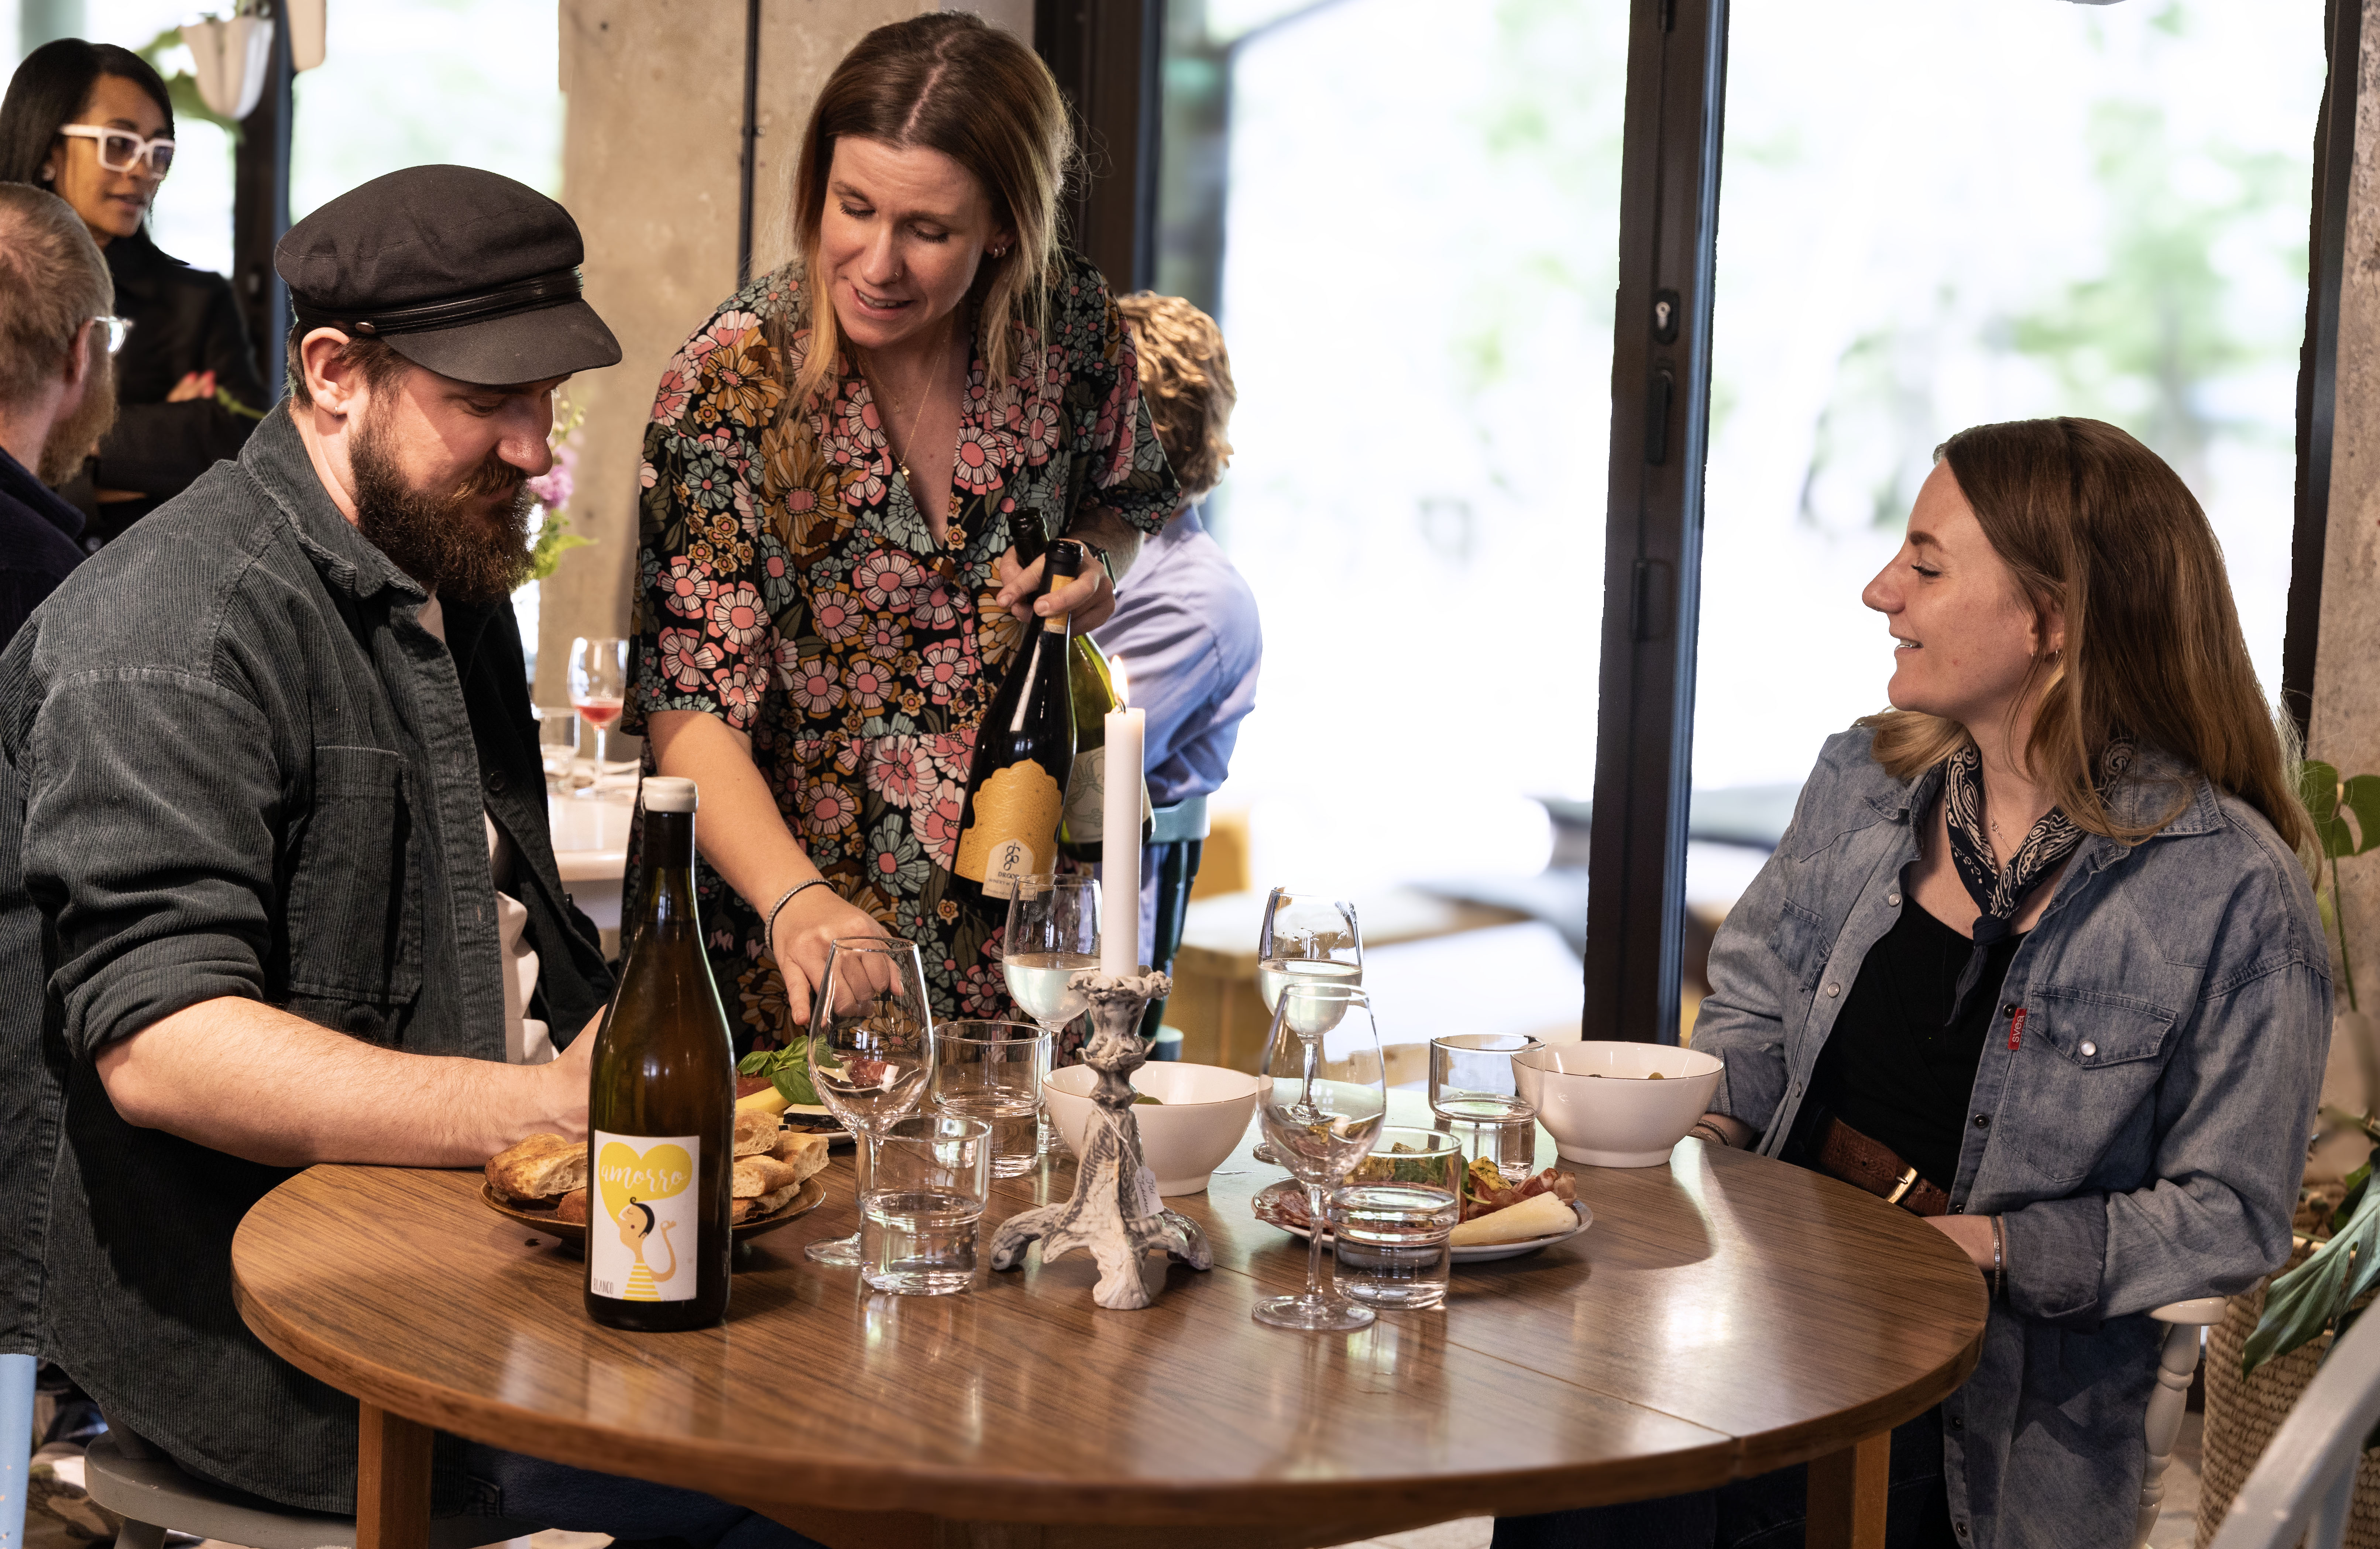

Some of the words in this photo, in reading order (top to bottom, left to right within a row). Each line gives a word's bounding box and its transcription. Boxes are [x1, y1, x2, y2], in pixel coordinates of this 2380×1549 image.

[2012, 1016, 2025, 1043] svea
[601, 1165, 687, 1192] amorro
[593, 1278, 614, 1294] BLANCO
